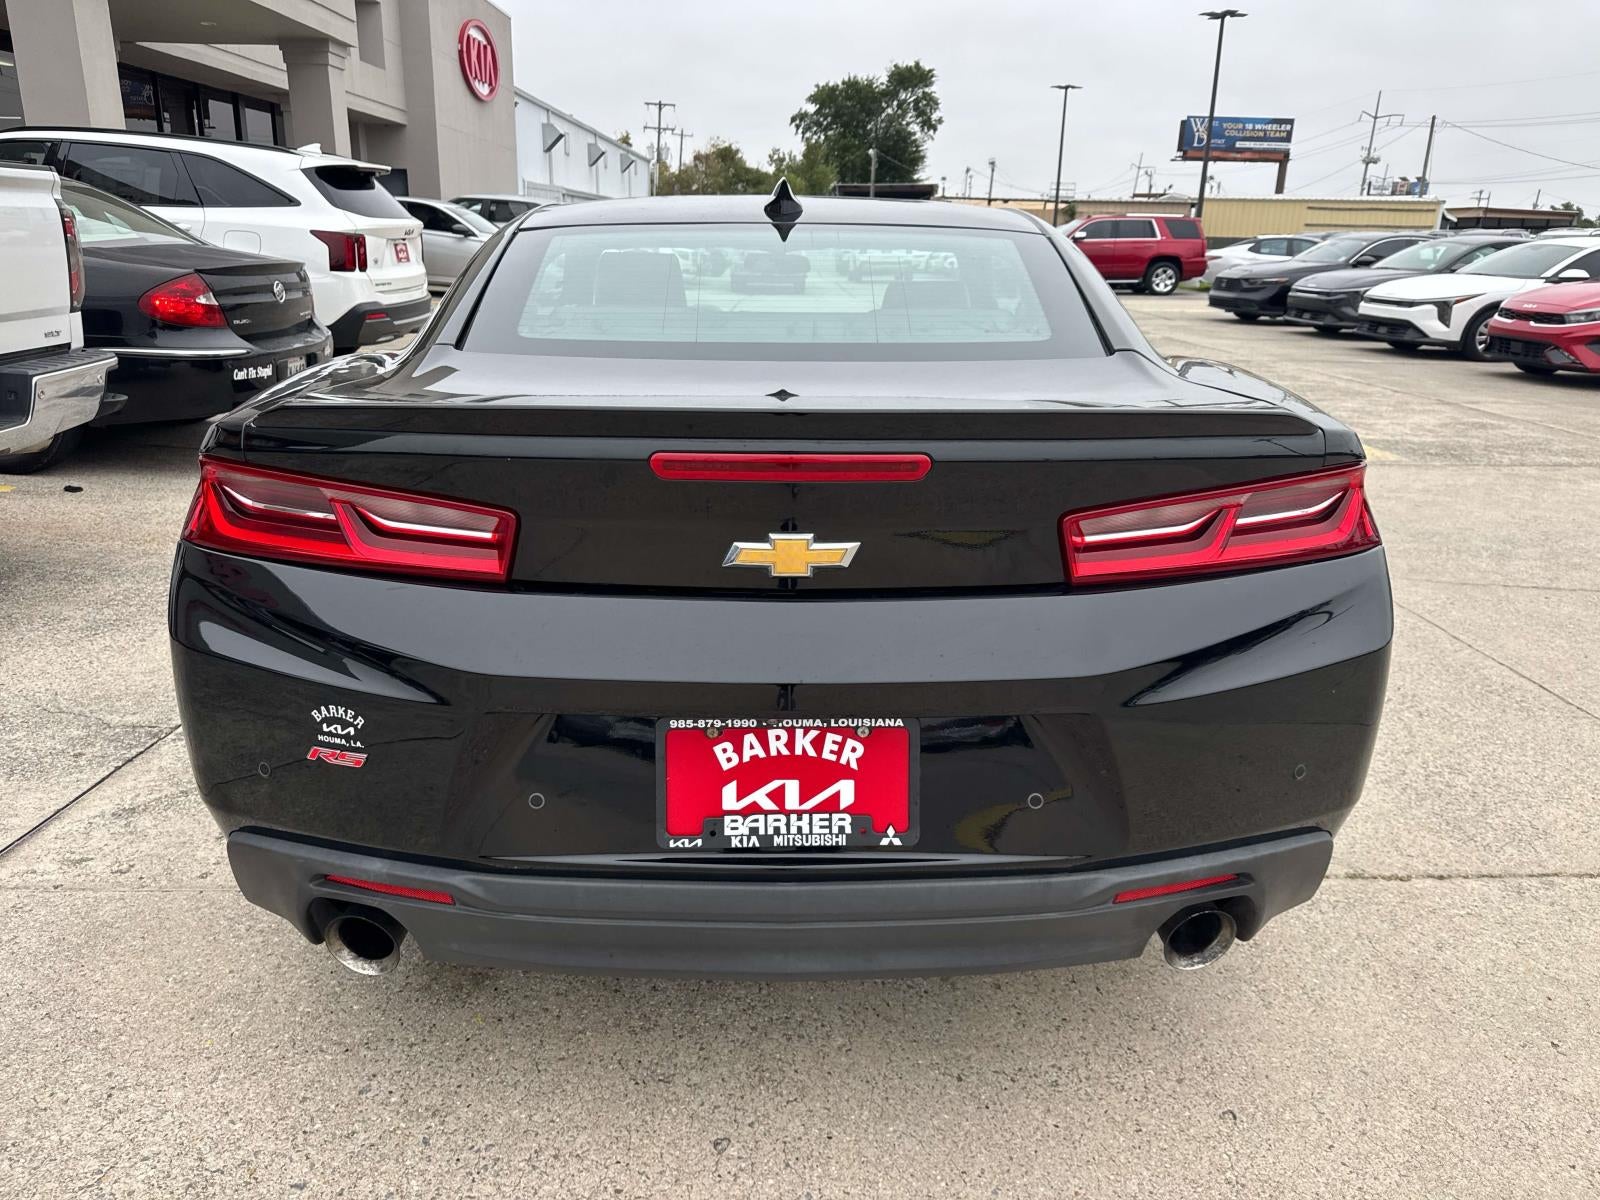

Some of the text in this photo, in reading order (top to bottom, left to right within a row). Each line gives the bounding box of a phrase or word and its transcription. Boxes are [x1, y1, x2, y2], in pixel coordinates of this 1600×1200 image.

[468, 34, 496, 87] KIA
[1222, 122, 1244, 130] YOUR
[1255, 123, 1292, 131] WHEELER
[1224, 129, 1288, 138] COLLISION TEAM
[233, 367, 248, 381] Can't
[248, 367, 257, 379] Fix
[257, 363, 273, 379] Stupid
[311, 704, 365, 729] BARKER
[669, 718, 757, 728] 985-879-1990
[830, 718, 904, 727] LOUISIANA
[317, 734, 365, 749] HOUMA, LA.
[712, 728, 865, 772] BARKER
[306, 746, 369, 768] RS
[722, 779, 855, 810] KIA
[723, 813, 852, 836] BARKER
[731, 834, 847, 848] KIA MITSUBISHI
